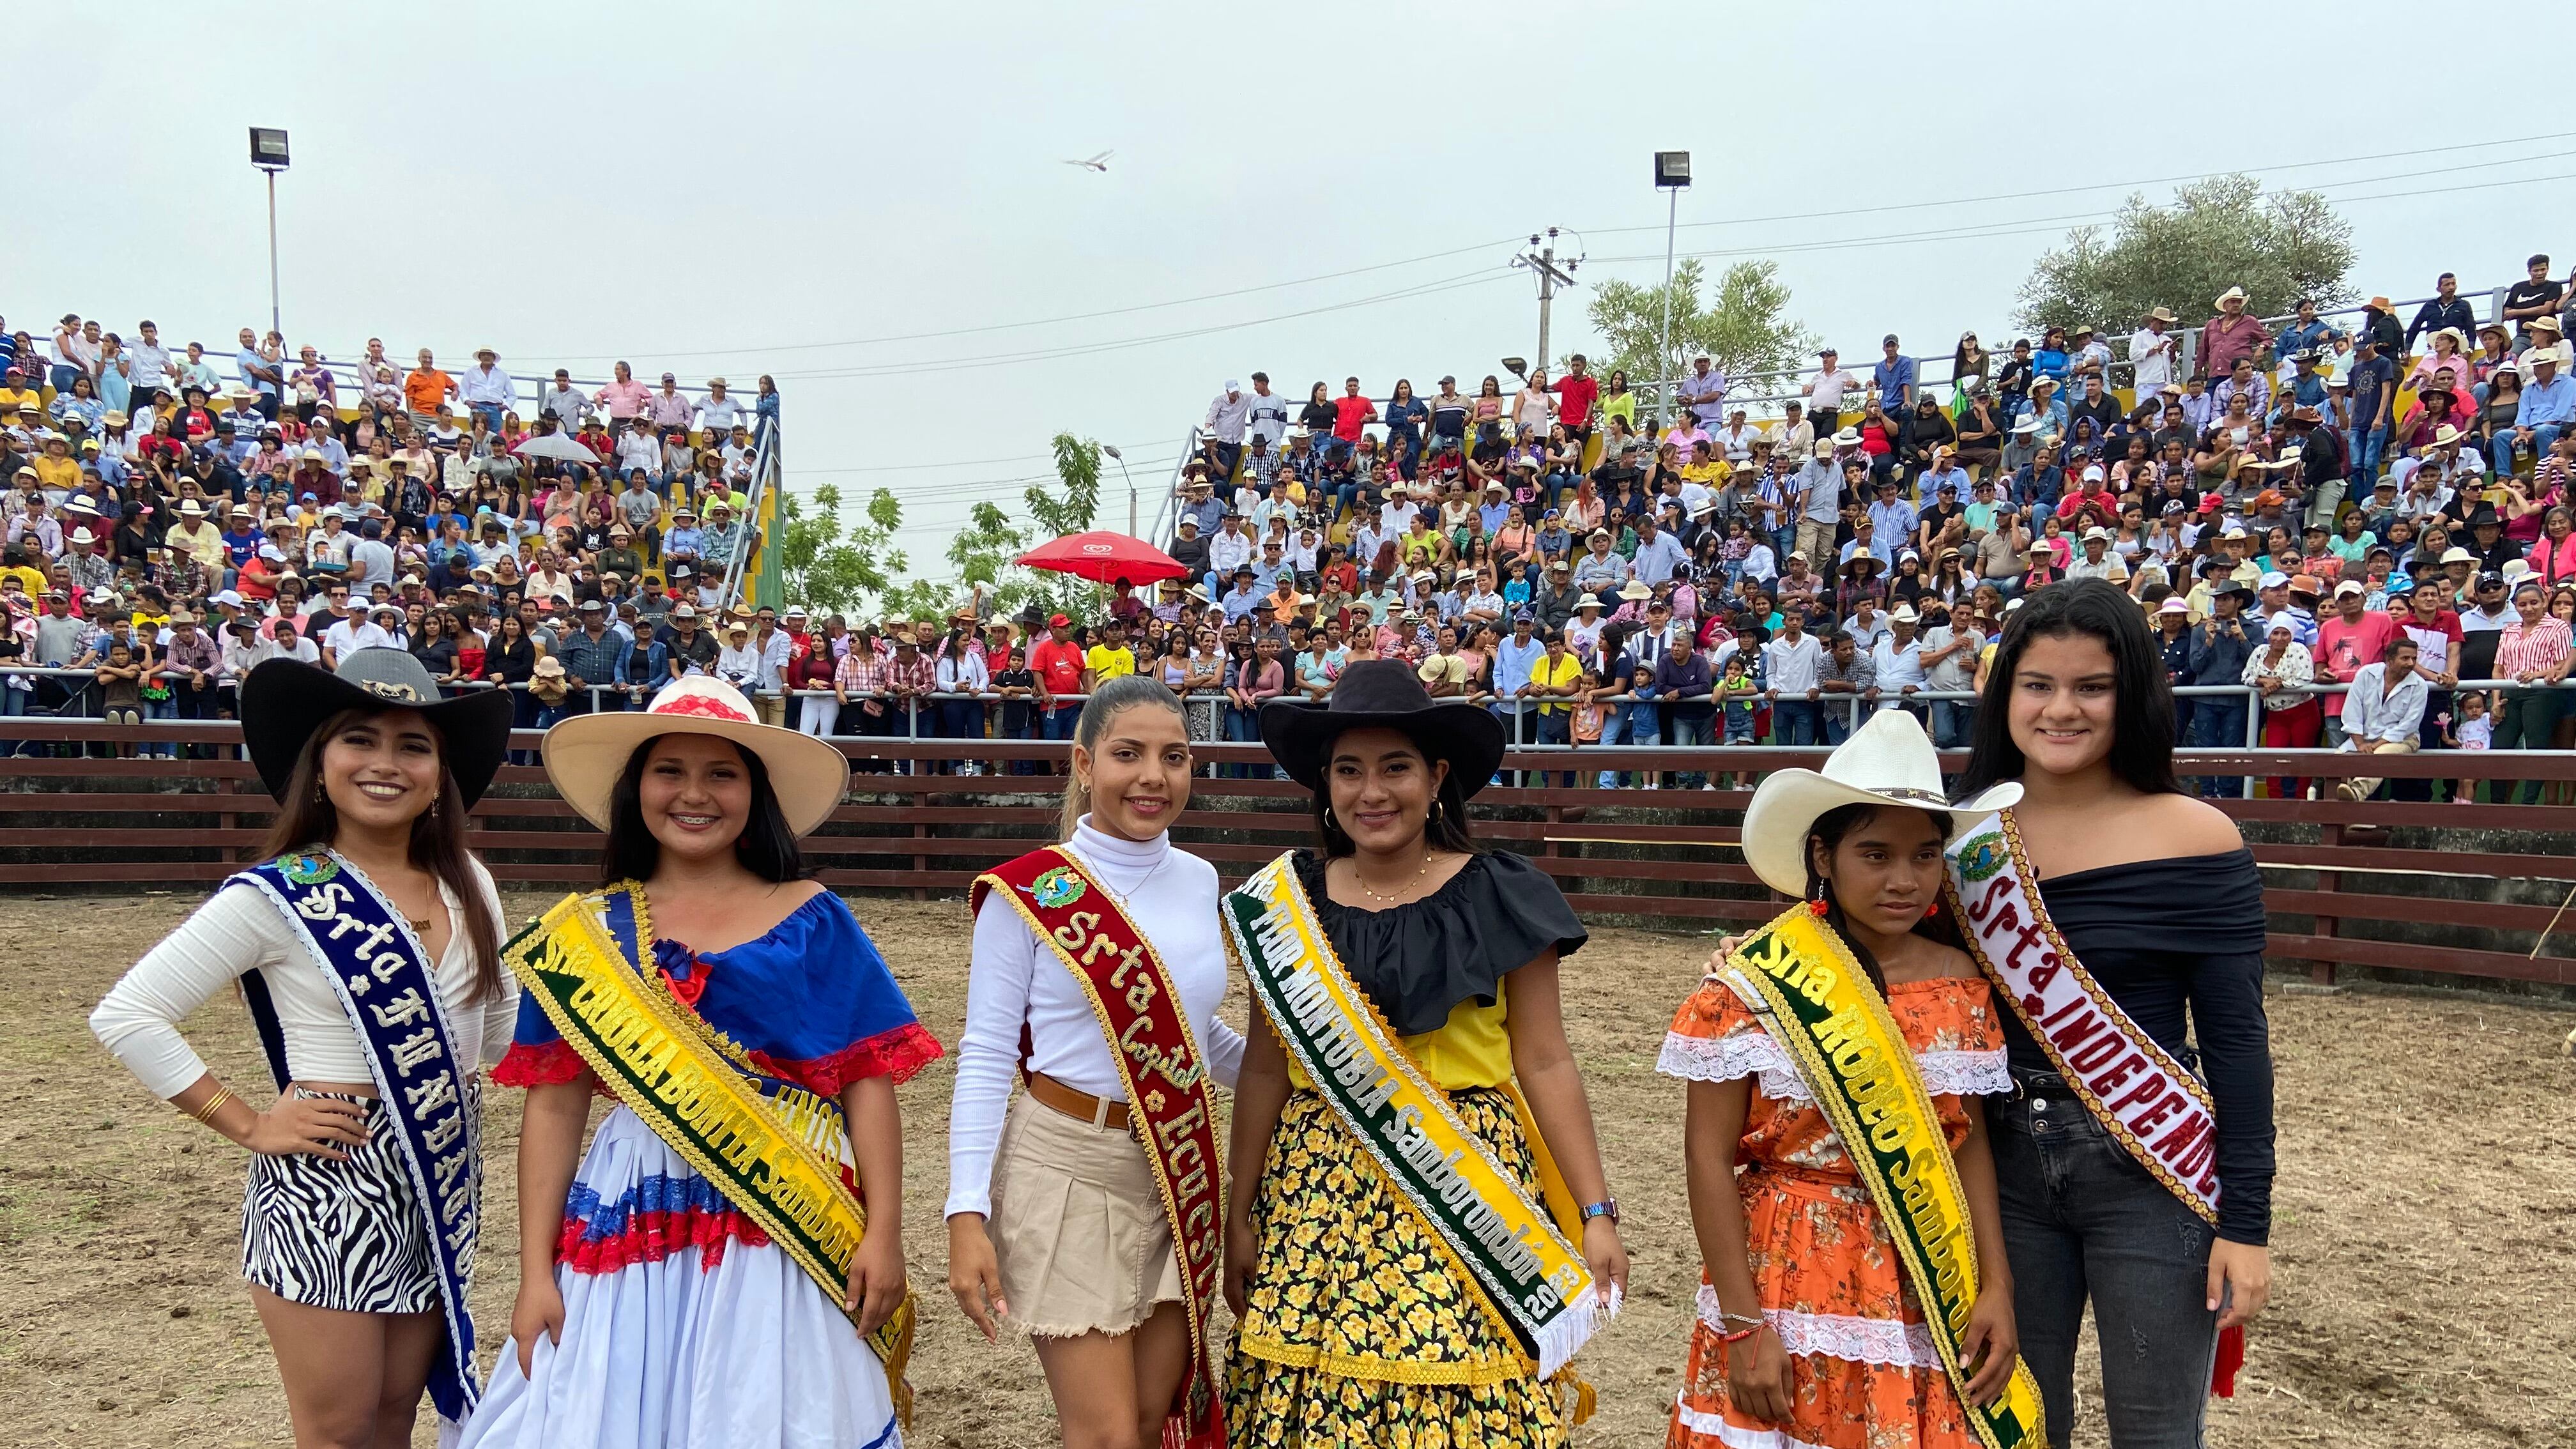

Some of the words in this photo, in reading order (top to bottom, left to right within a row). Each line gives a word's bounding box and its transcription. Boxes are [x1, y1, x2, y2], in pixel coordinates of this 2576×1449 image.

[293, 883, 408, 984] Srta
[1054, 911, 1158, 1015] Srta
[1968, 875, 2063, 993] Srta
[2039, 995, 2222, 1208] INDEPENDE
[570, 971, 680, 1092] CRIOLLA
[654, 1059, 772, 1176] BONITA
[751, 1146, 860, 1276] Samboro
[1250, 900, 1305, 978] FLOR
[1278, 959, 1402, 1118] MONTUBIA
[1379, 1103, 1545, 1287] Samborondón
[1524, 1262, 1580, 1320] 2023
[1811, 1002, 1917, 1153] RODEO
